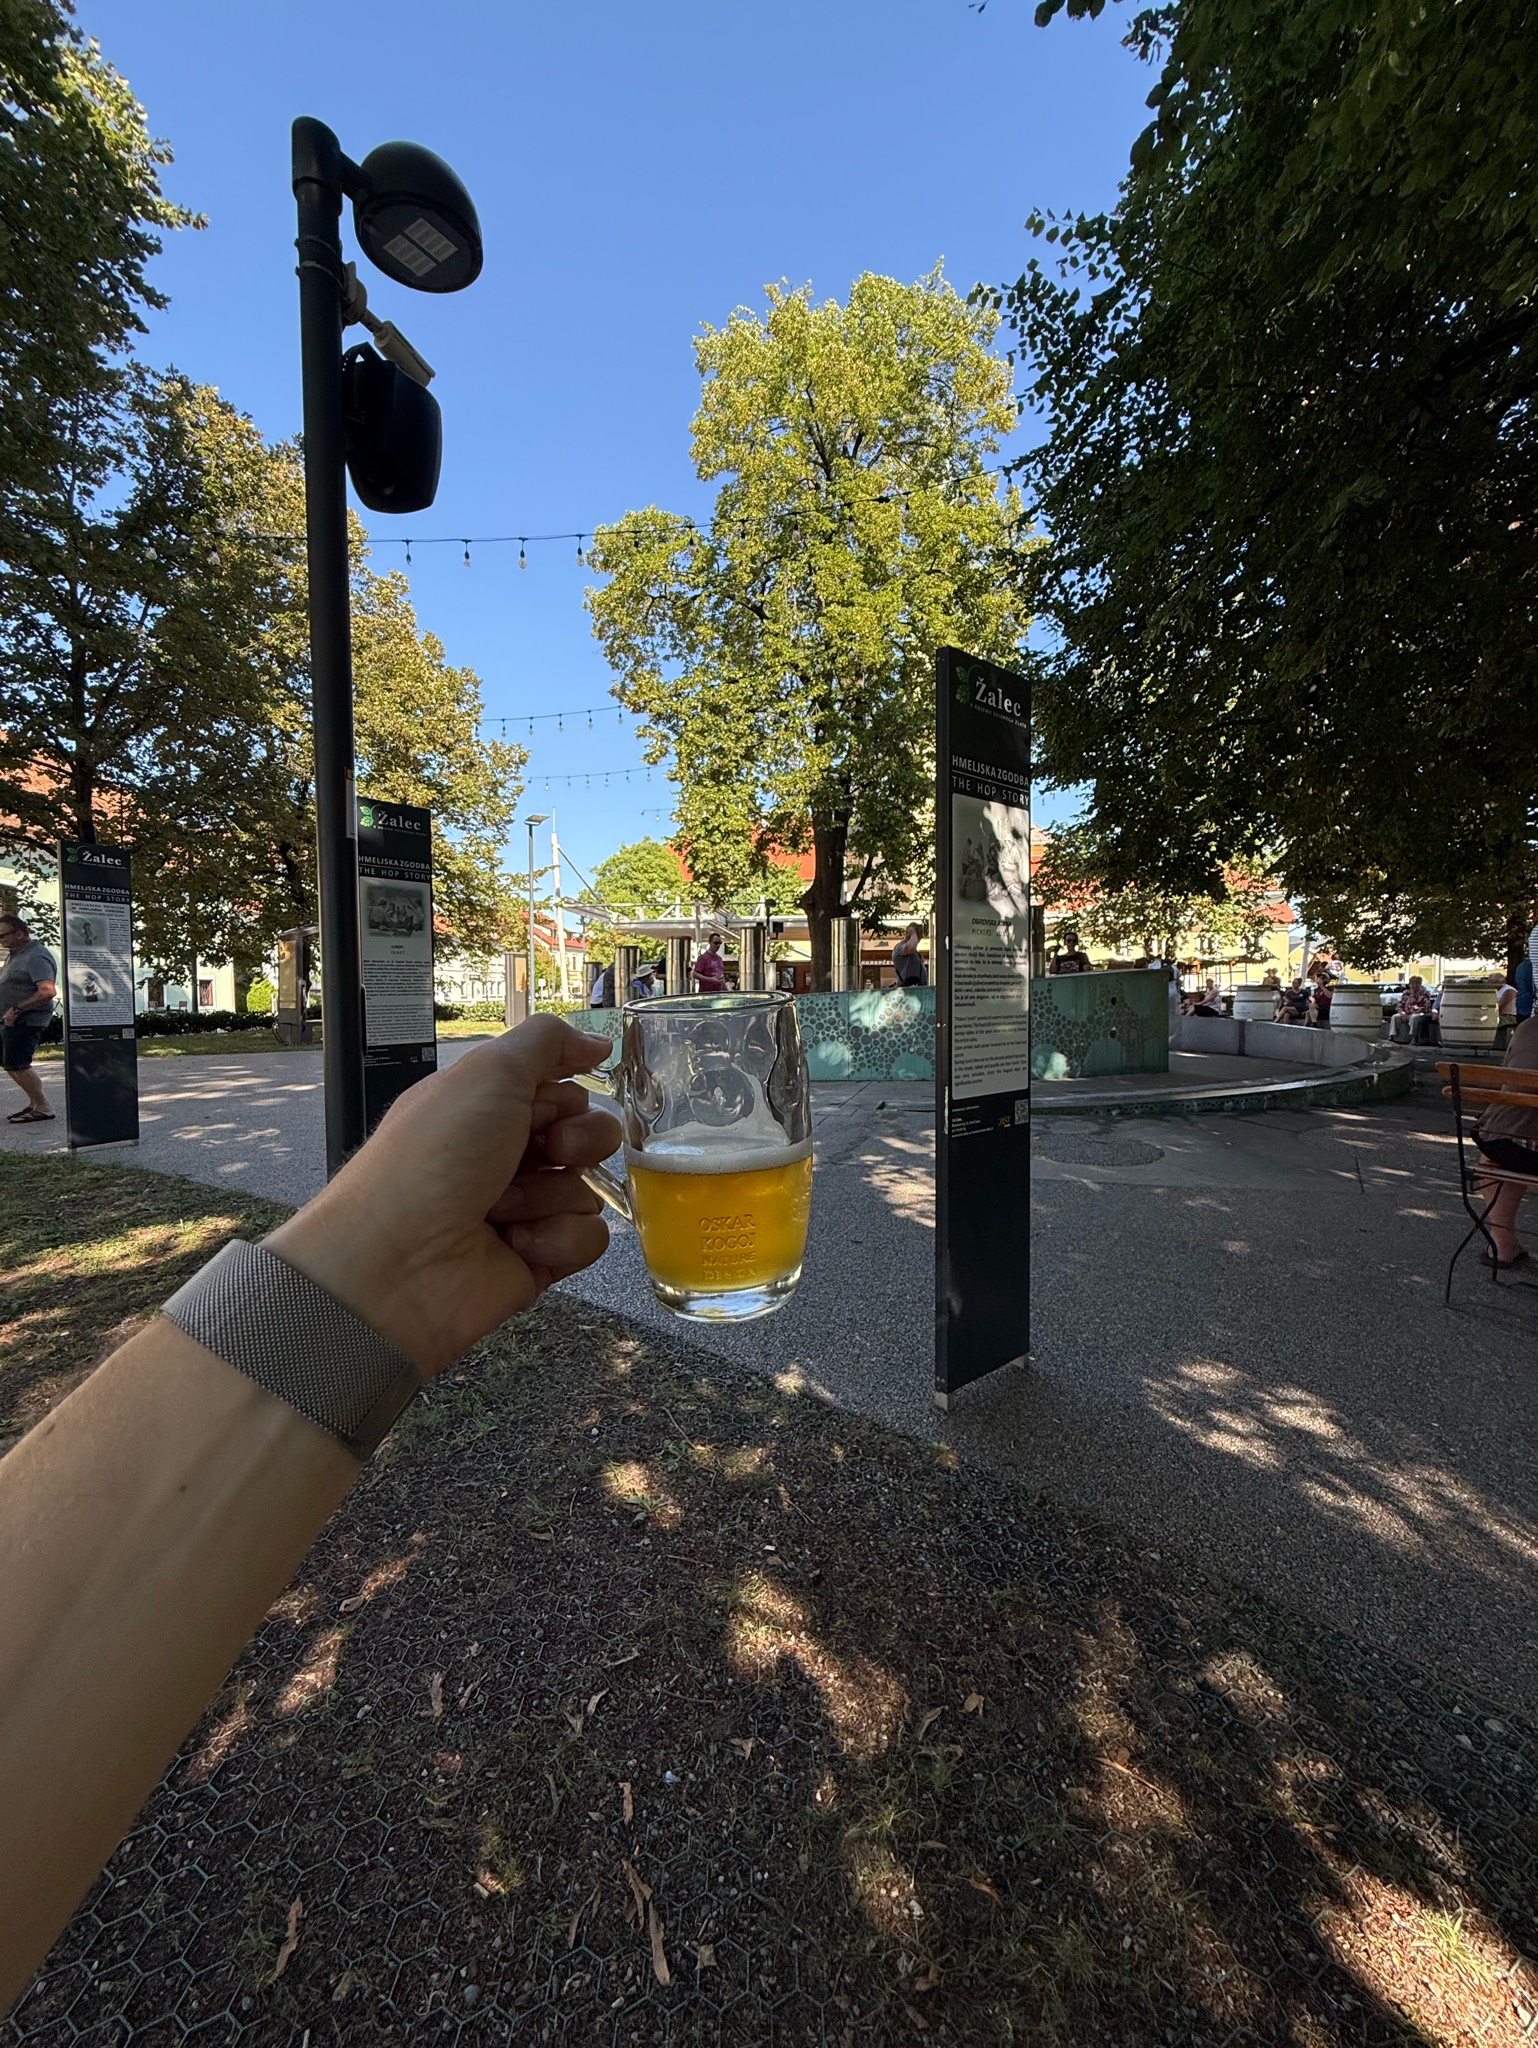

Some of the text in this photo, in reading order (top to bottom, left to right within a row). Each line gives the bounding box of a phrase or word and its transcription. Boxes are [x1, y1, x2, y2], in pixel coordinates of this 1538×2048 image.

[975, 675, 1021, 717] Žalec
[952, 754, 1030, 787] HMELJSKA ZGODBA
[952, 775, 1030, 806] THE HOP STORY
[378, 810, 421, 831] Žalec
[82, 850, 122, 866] Žalec
[358, 855, 431, 870] HMELJSKA ZGODBA
[358, 866, 432, 881] THE HOP STORY
[64, 883, 130, 895] HMELJSKA ZGODBA
[699, 1213, 756, 1233] OSKAR
[701, 1232, 756, 1253] KOGOJ
[703, 1252, 757, 1267] NATURE
